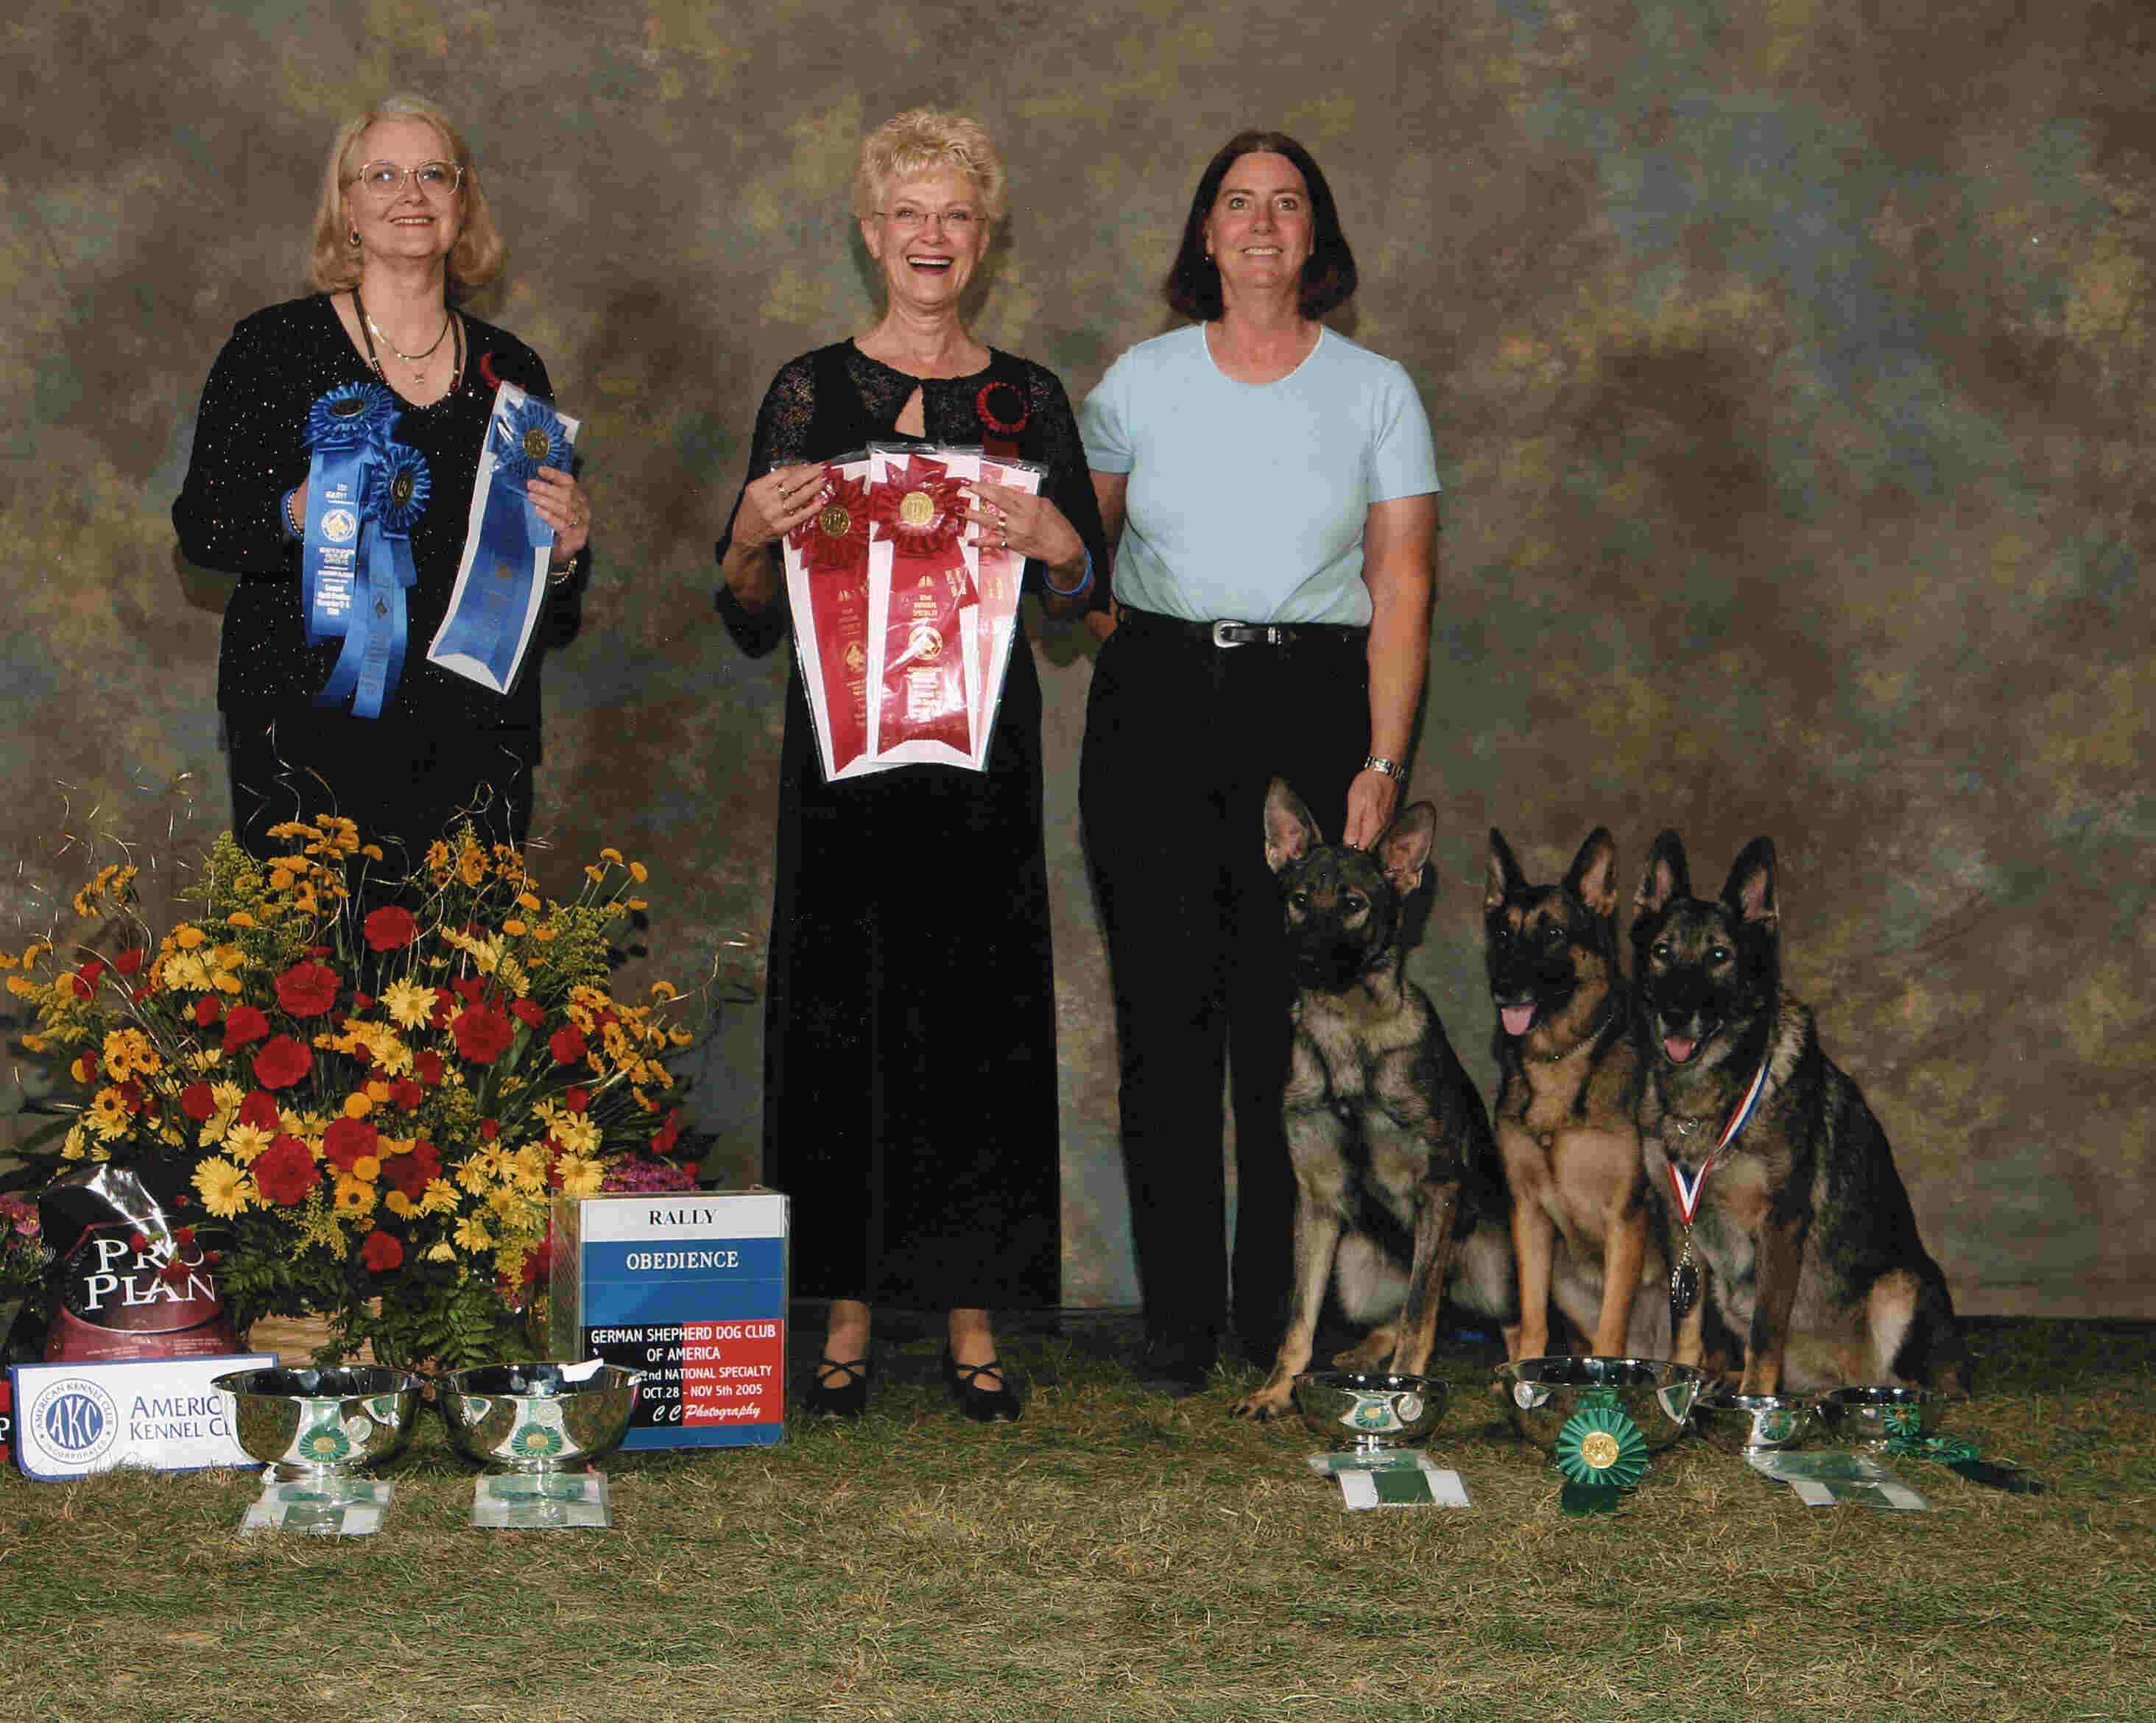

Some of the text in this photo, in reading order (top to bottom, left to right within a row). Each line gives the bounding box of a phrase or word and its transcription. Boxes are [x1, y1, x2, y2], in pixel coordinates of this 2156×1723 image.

[649, 1208, 718, 1225] RALLY
[626, 1251, 739, 1269] OBEDIENCE
[83, 1272, 216, 1311] PLAN
[591, 1324, 776, 1344] GERMAN SHEPHERD DOG CLUB
[647, 1346, 721, 1361] OF AMERICA
[665, 1367, 716, 1381] NATIONAL
[719, 1364, 772, 1378] SPECIALTY
[691, 1385, 713, 1398] NOV
[715, 1384, 733, 1397] 5th
[736, 1383, 763, 1396] 2005
[130, 1395, 222, 1419] AMERIC
[684, 1400, 761, 1421] Photography
[49, 1395, 102, 1448] AKC
[129, 1417, 230, 1441] KENNEL CL
